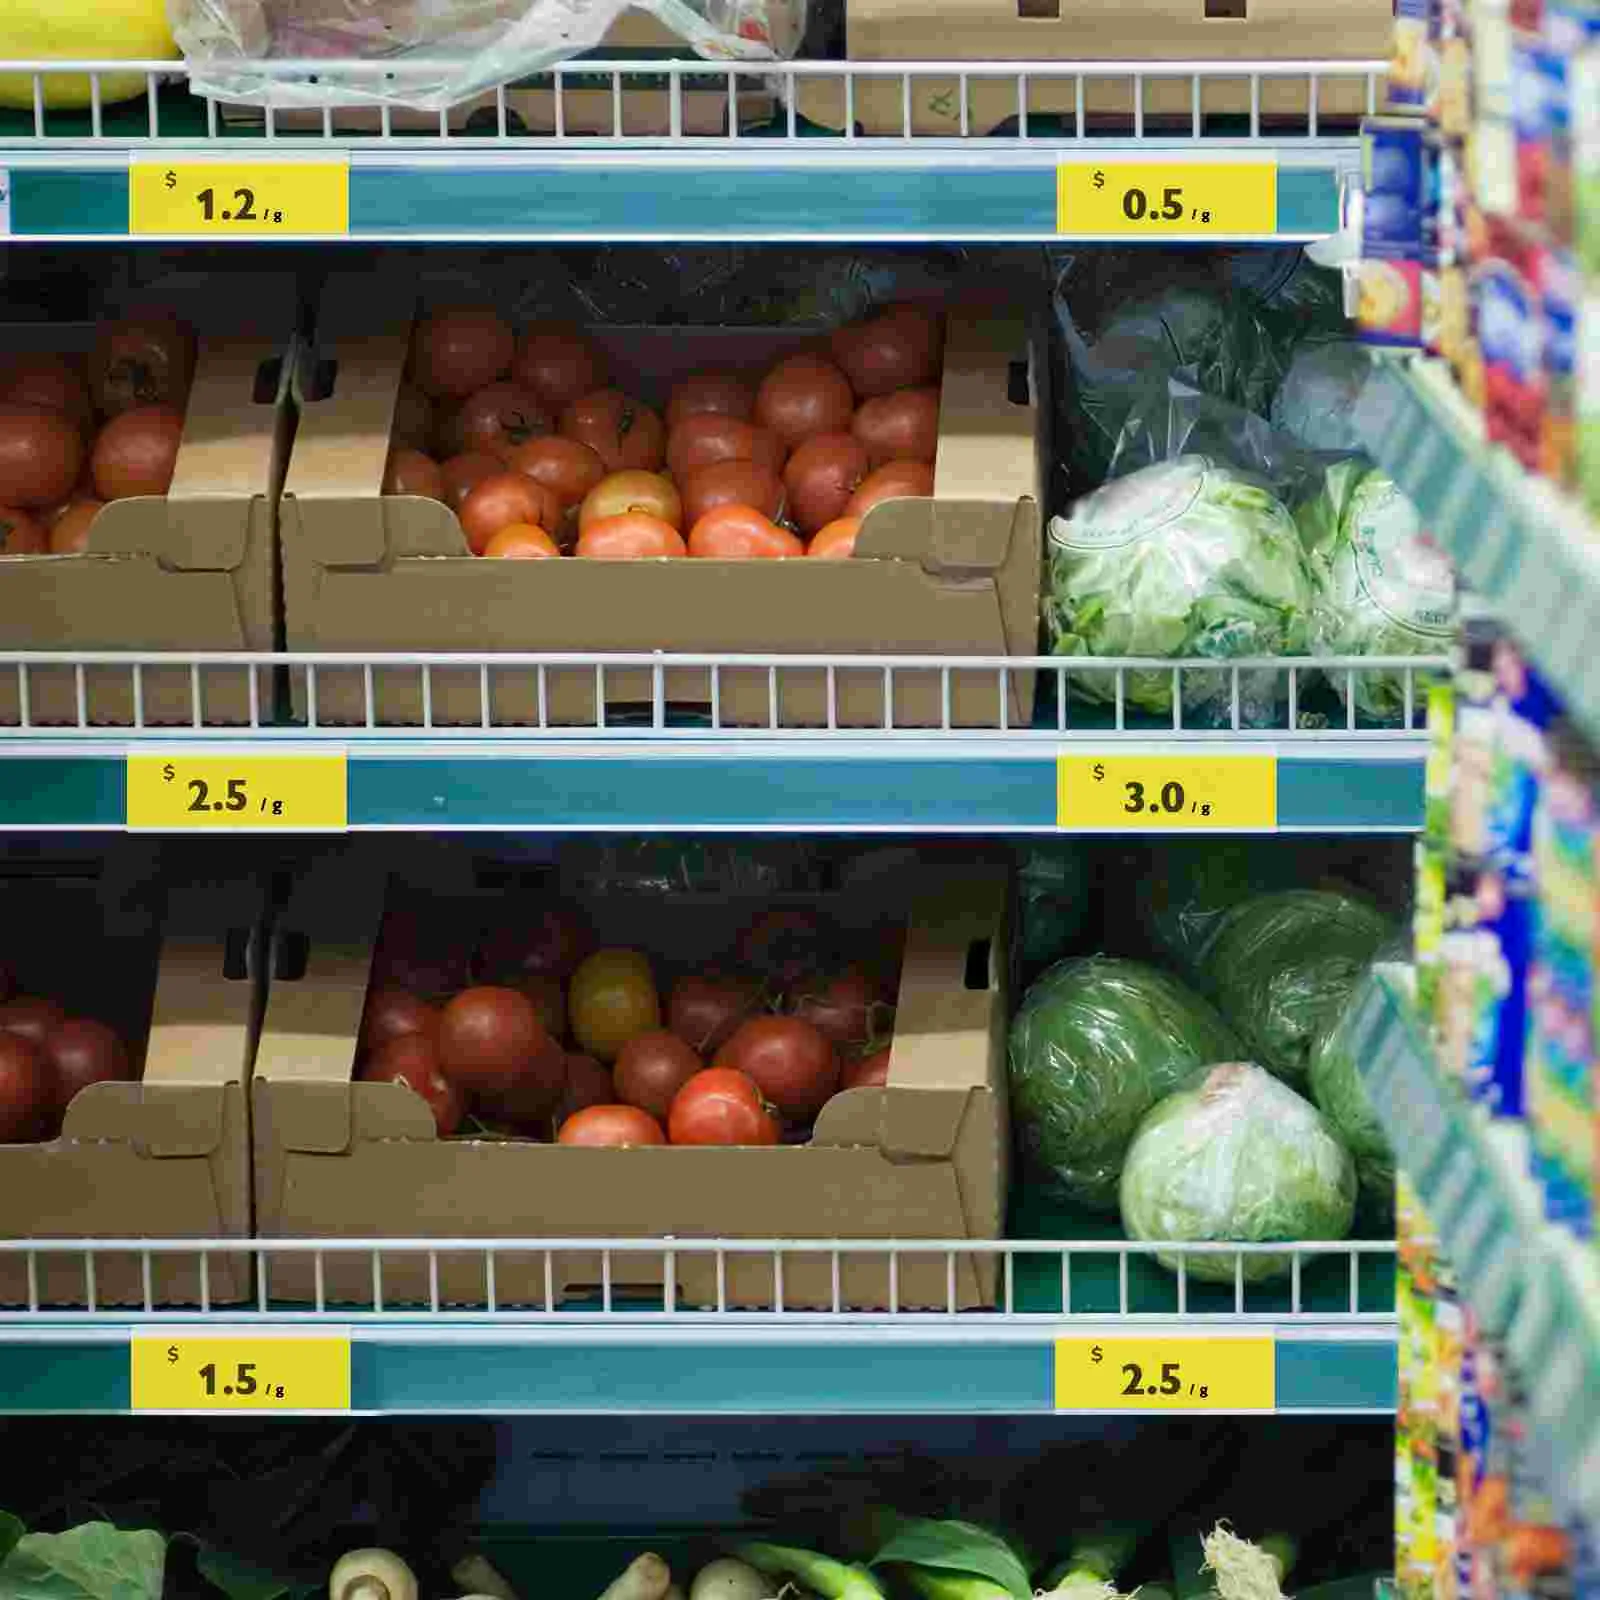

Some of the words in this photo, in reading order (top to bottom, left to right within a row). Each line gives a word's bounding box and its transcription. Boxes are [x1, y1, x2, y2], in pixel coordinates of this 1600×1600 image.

[165, 170, 177, 189] $
[196, 188, 257, 221] 1.2
[1093, 170, 1105, 189] $
[1122, 188, 1184, 221] 0.5
[163, 763, 176, 782] $
[187, 779, 248, 812] 2.5
[1093, 763, 1105, 782] $
[1124, 781, 1185, 814] 3.0
[167, 1345, 179, 1364] $
[198, 1363, 257, 1396] 1.5
[1091, 1344, 1103, 1364] $
[1121, 1363, 1181, 1396] 2.5
